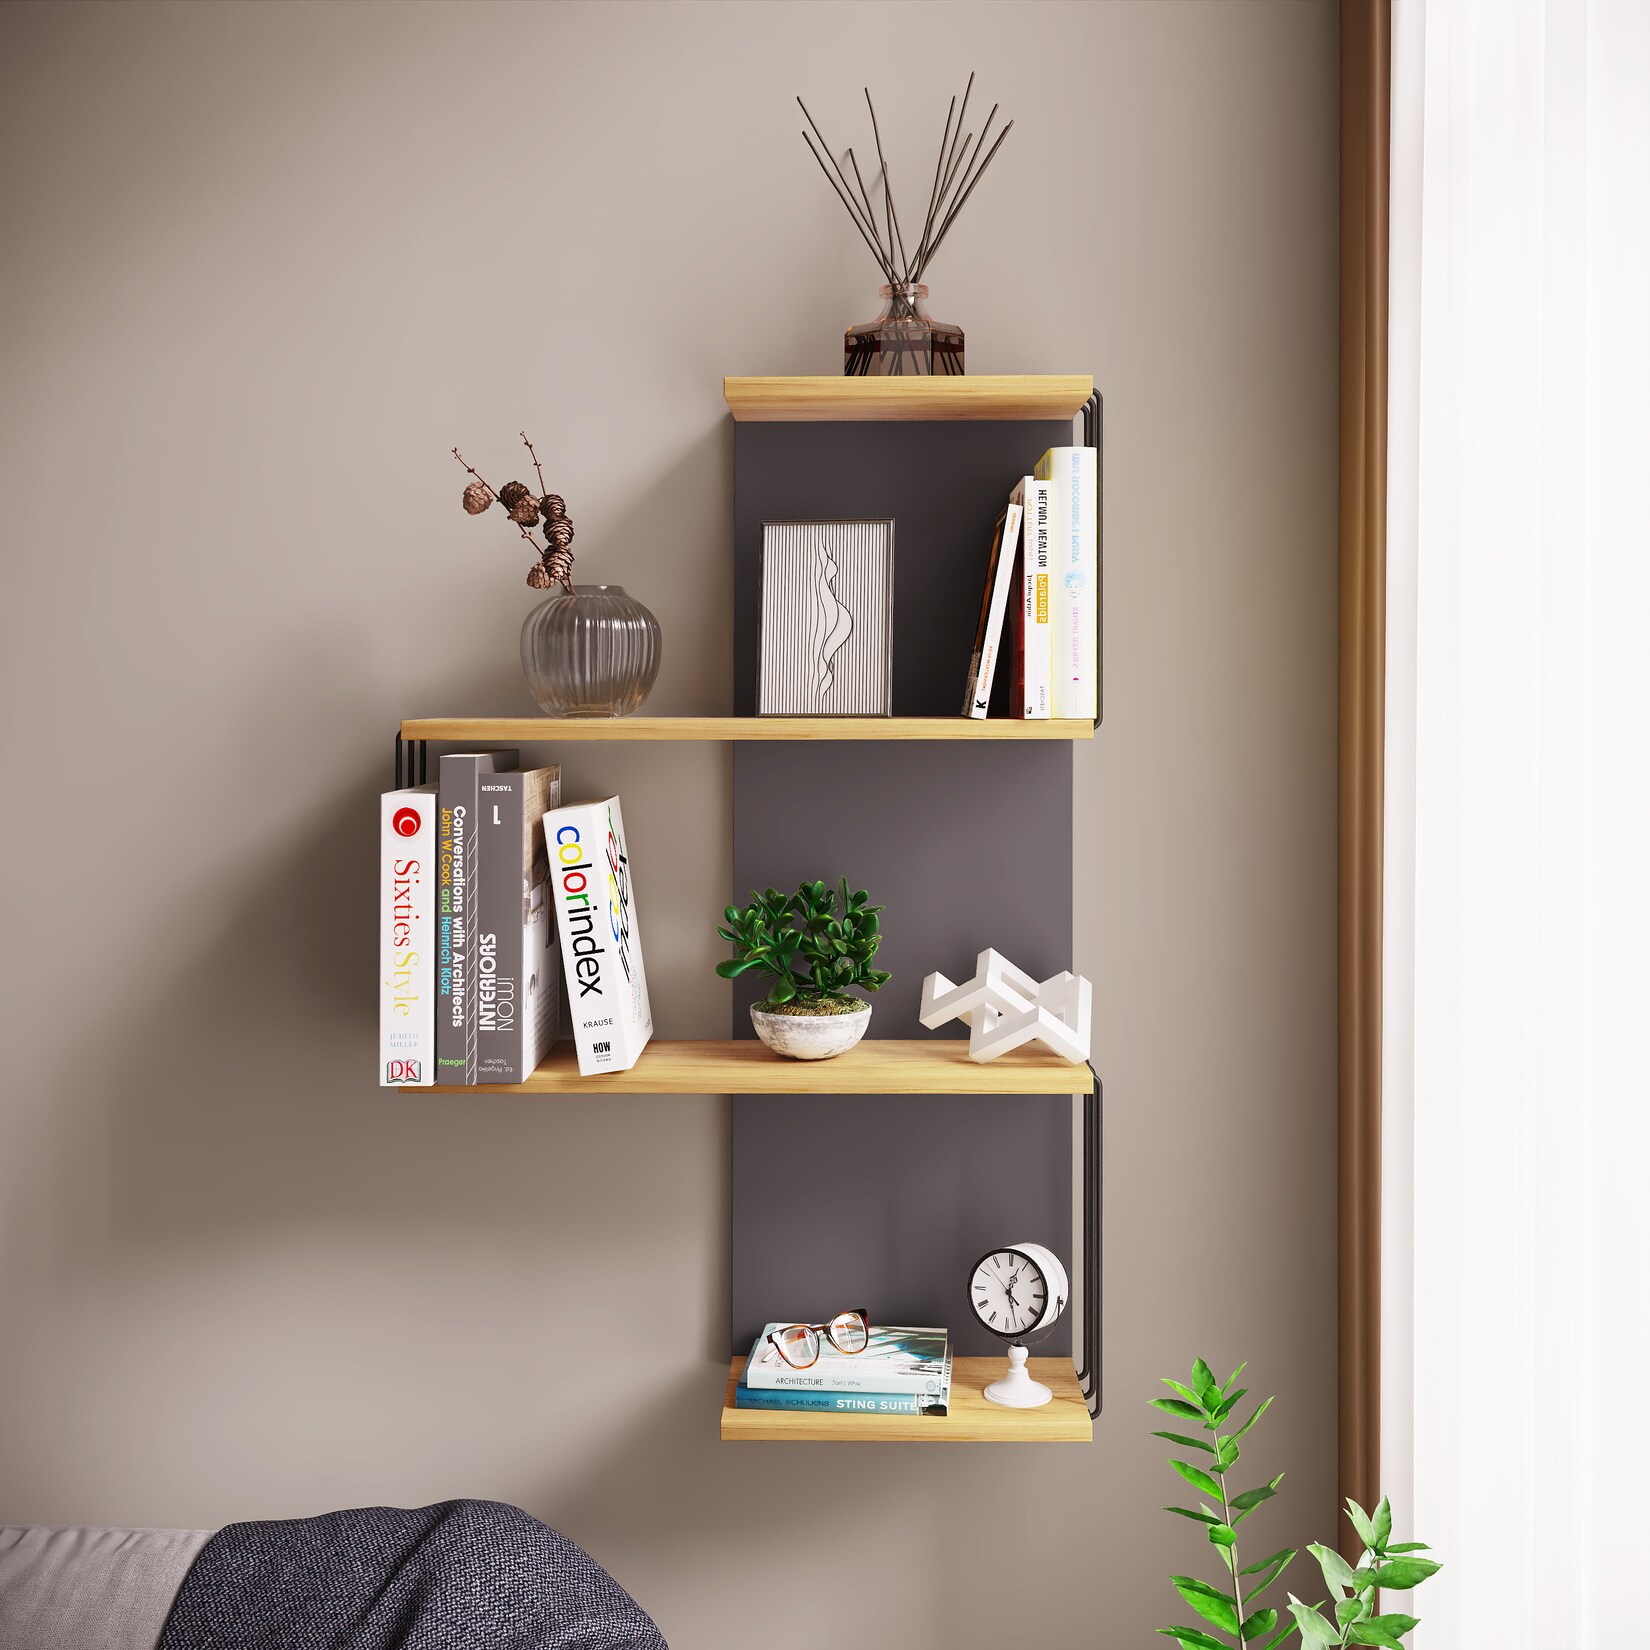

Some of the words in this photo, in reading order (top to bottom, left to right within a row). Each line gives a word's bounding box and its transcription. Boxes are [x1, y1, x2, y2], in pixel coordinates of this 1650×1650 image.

[441, 807, 453, 836] John
[452, 805, 467, 913] Conversations
[393, 859, 420, 947] Sixties
[441, 889, 453, 913] and
[556, 825, 605, 998] colorindex
[441, 917, 453, 964] Heinrich
[452, 917, 467, 948] with
[385, 952, 420, 1016] Style
[441, 967, 452, 995] Klotz
[452, 952, 466, 1028] Architects
[479, 933, 497, 1031] INTERIORS
[496, 977, 514, 1031] NOW!
[583, 1018, 613, 1028] KRAUSE
[593, 1041, 611, 1053] HOW
[390, 1060, 418, 1079] DK
[439, 1058, 466, 1067] Praeger
[776, 1377, 823, 1386] ARCHITECTURE
[786, 1399, 829, 1407] SCHULKINS
[836, 1399, 876, 1409] STING
[879, 1400, 917, 1411] SUITE
